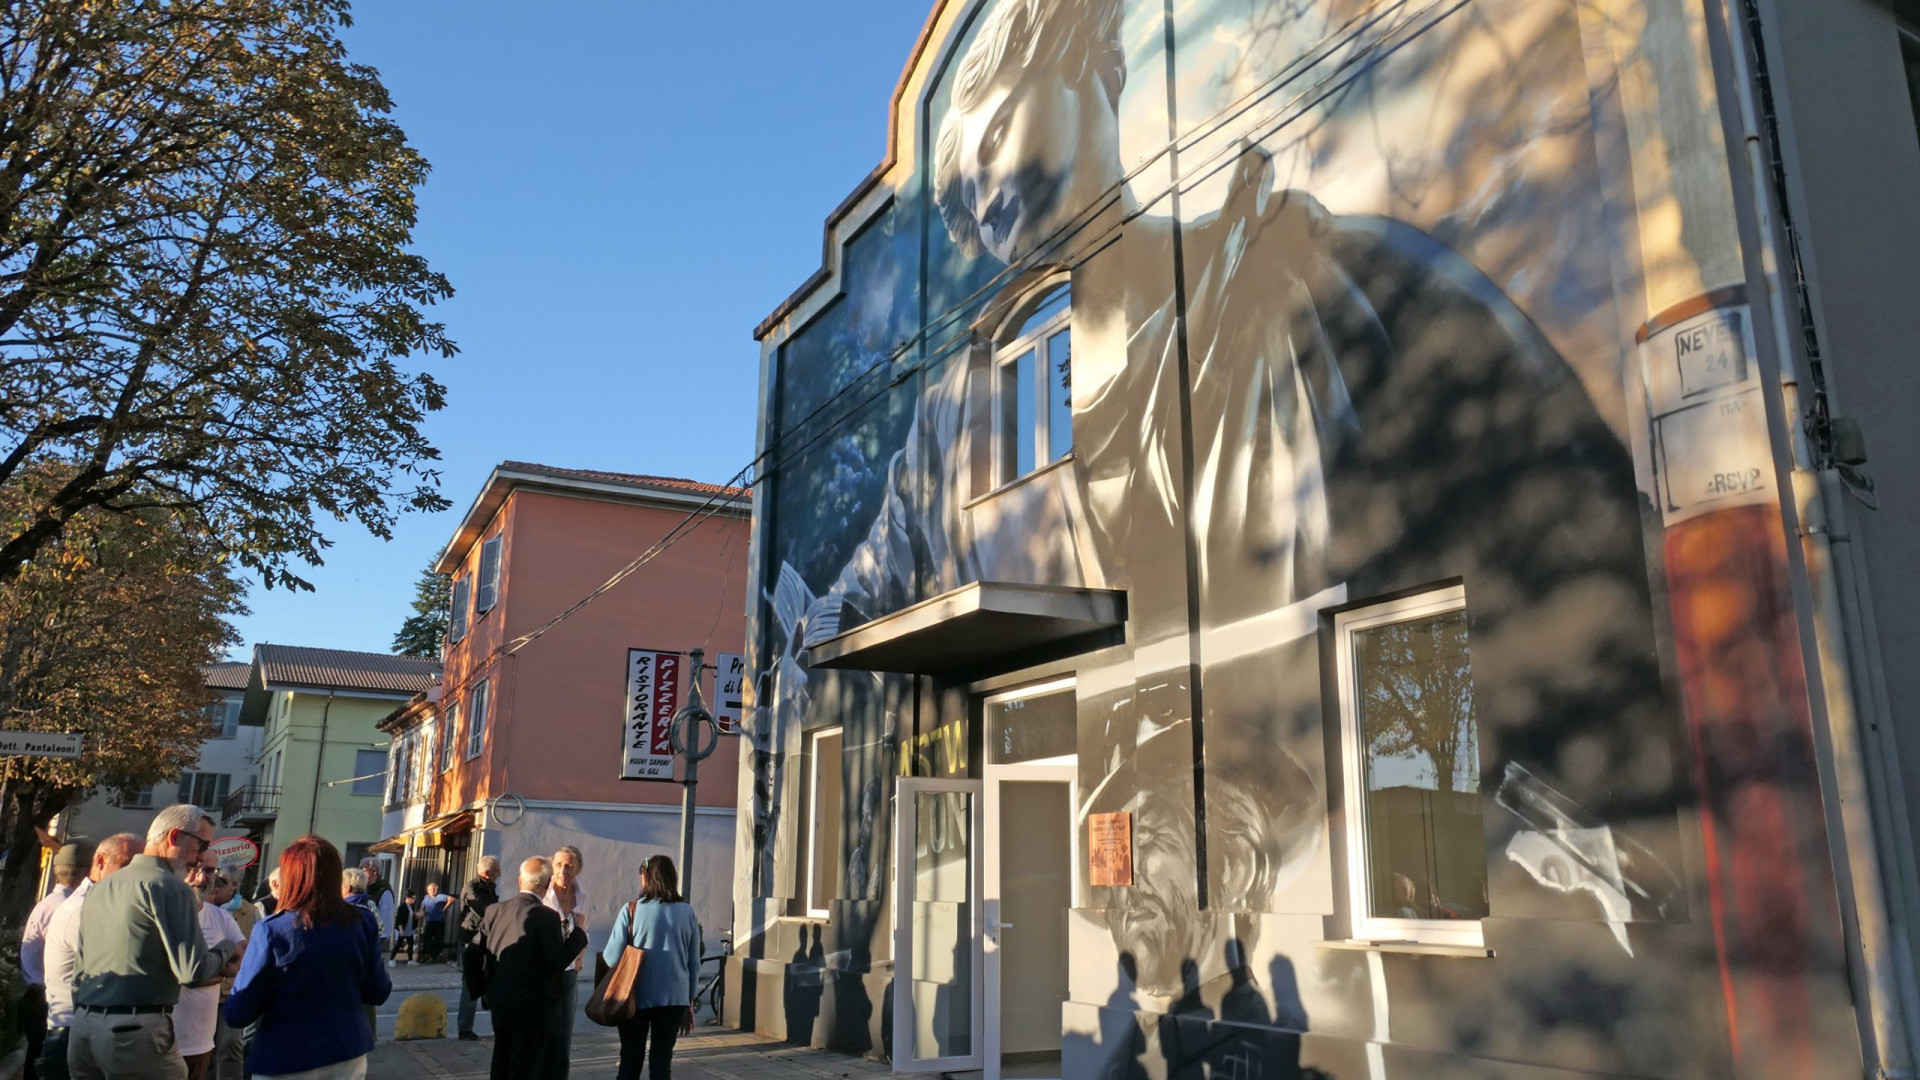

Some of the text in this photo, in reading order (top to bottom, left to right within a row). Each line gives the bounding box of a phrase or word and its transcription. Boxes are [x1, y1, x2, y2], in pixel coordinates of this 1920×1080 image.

[632, 656, 651, 749] RISTORANTE
[655, 659, 674, 750] PIZZERIA
[724, 680, 735, 694] di
[25, 743, 75, 753] Pantaleoni
